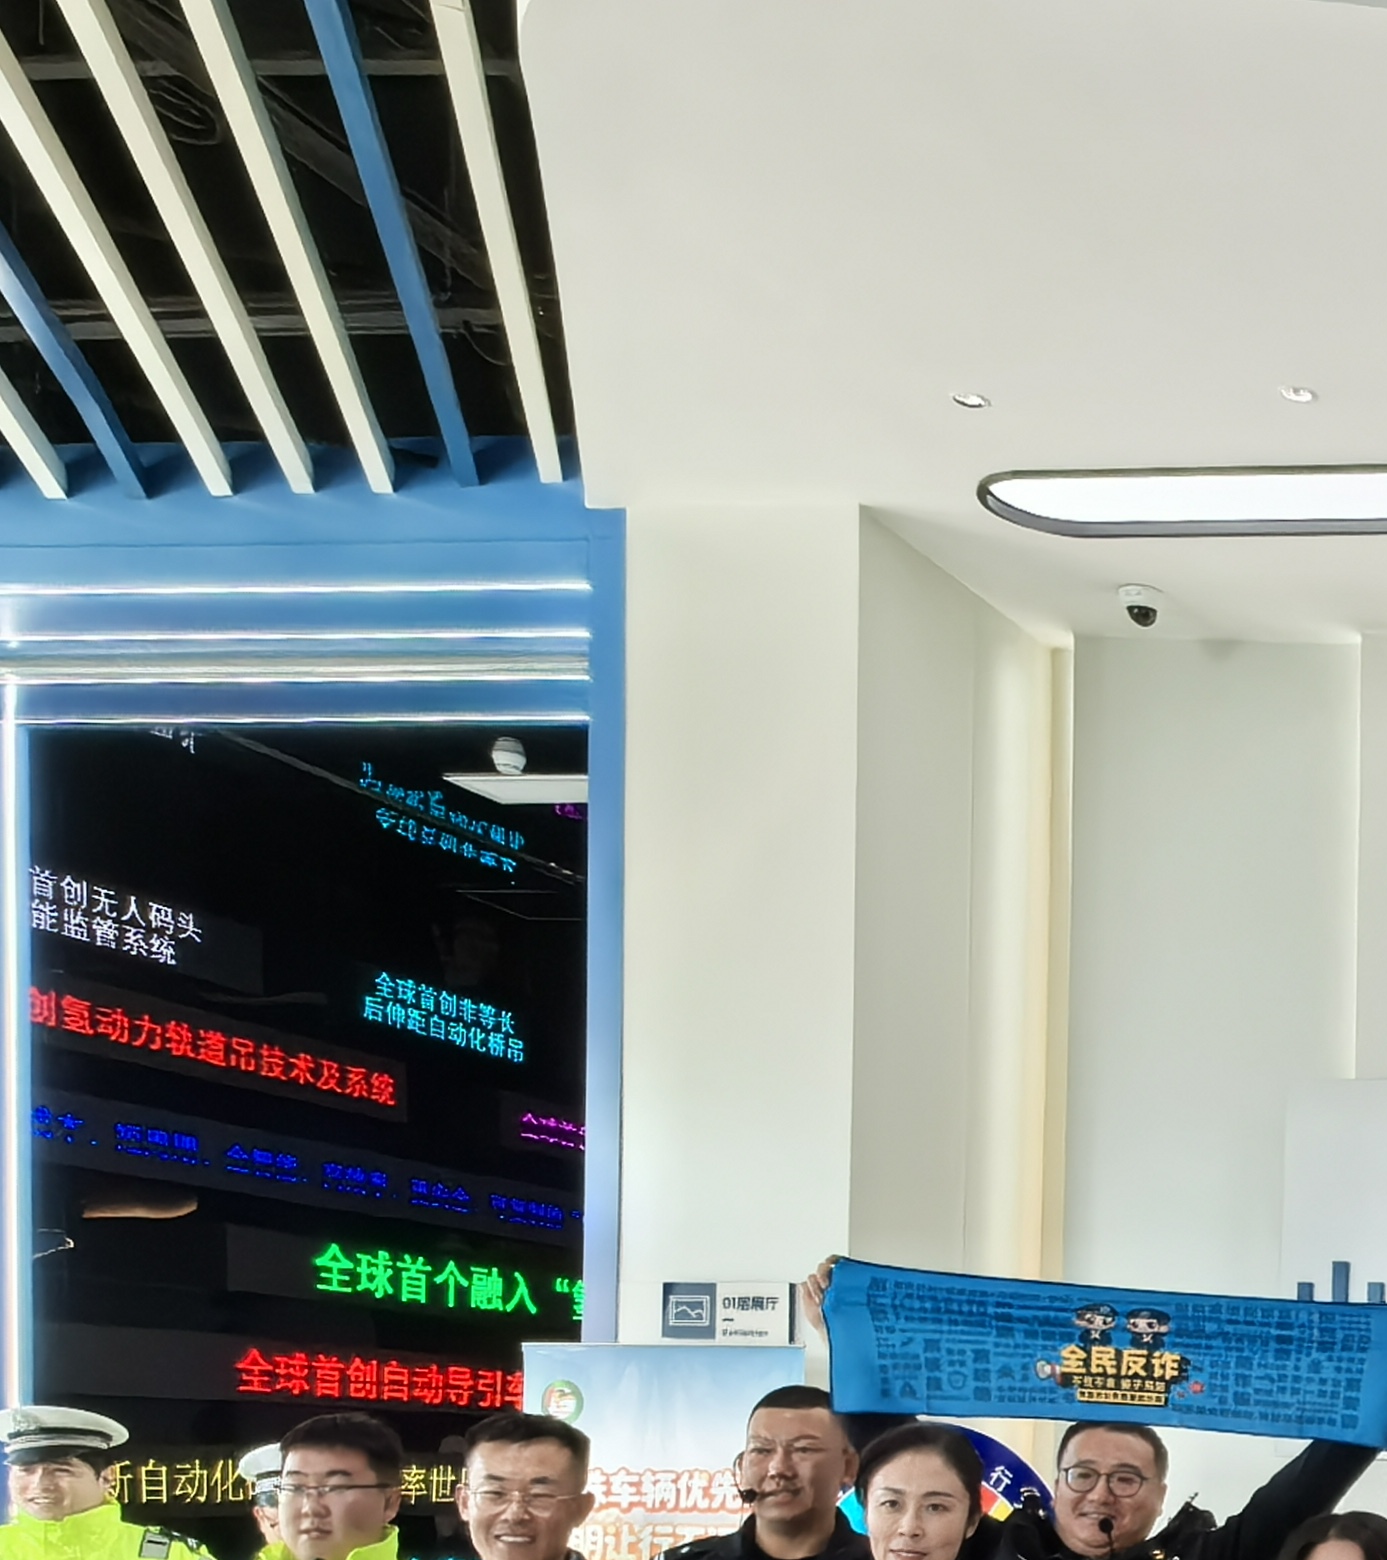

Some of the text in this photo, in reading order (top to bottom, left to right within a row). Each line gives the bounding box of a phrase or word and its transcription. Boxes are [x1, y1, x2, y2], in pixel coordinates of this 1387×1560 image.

[29, 865, 202, 943] 首创无人码头
[31, 899, 177, 965] 能监管系统
[363, 995, 524, 1063] 后伸距自动化桥吊
[375, 971, 515, 1034] 全球首创非等长
[1060, 1344, 1181, 1381] 全民反诈
